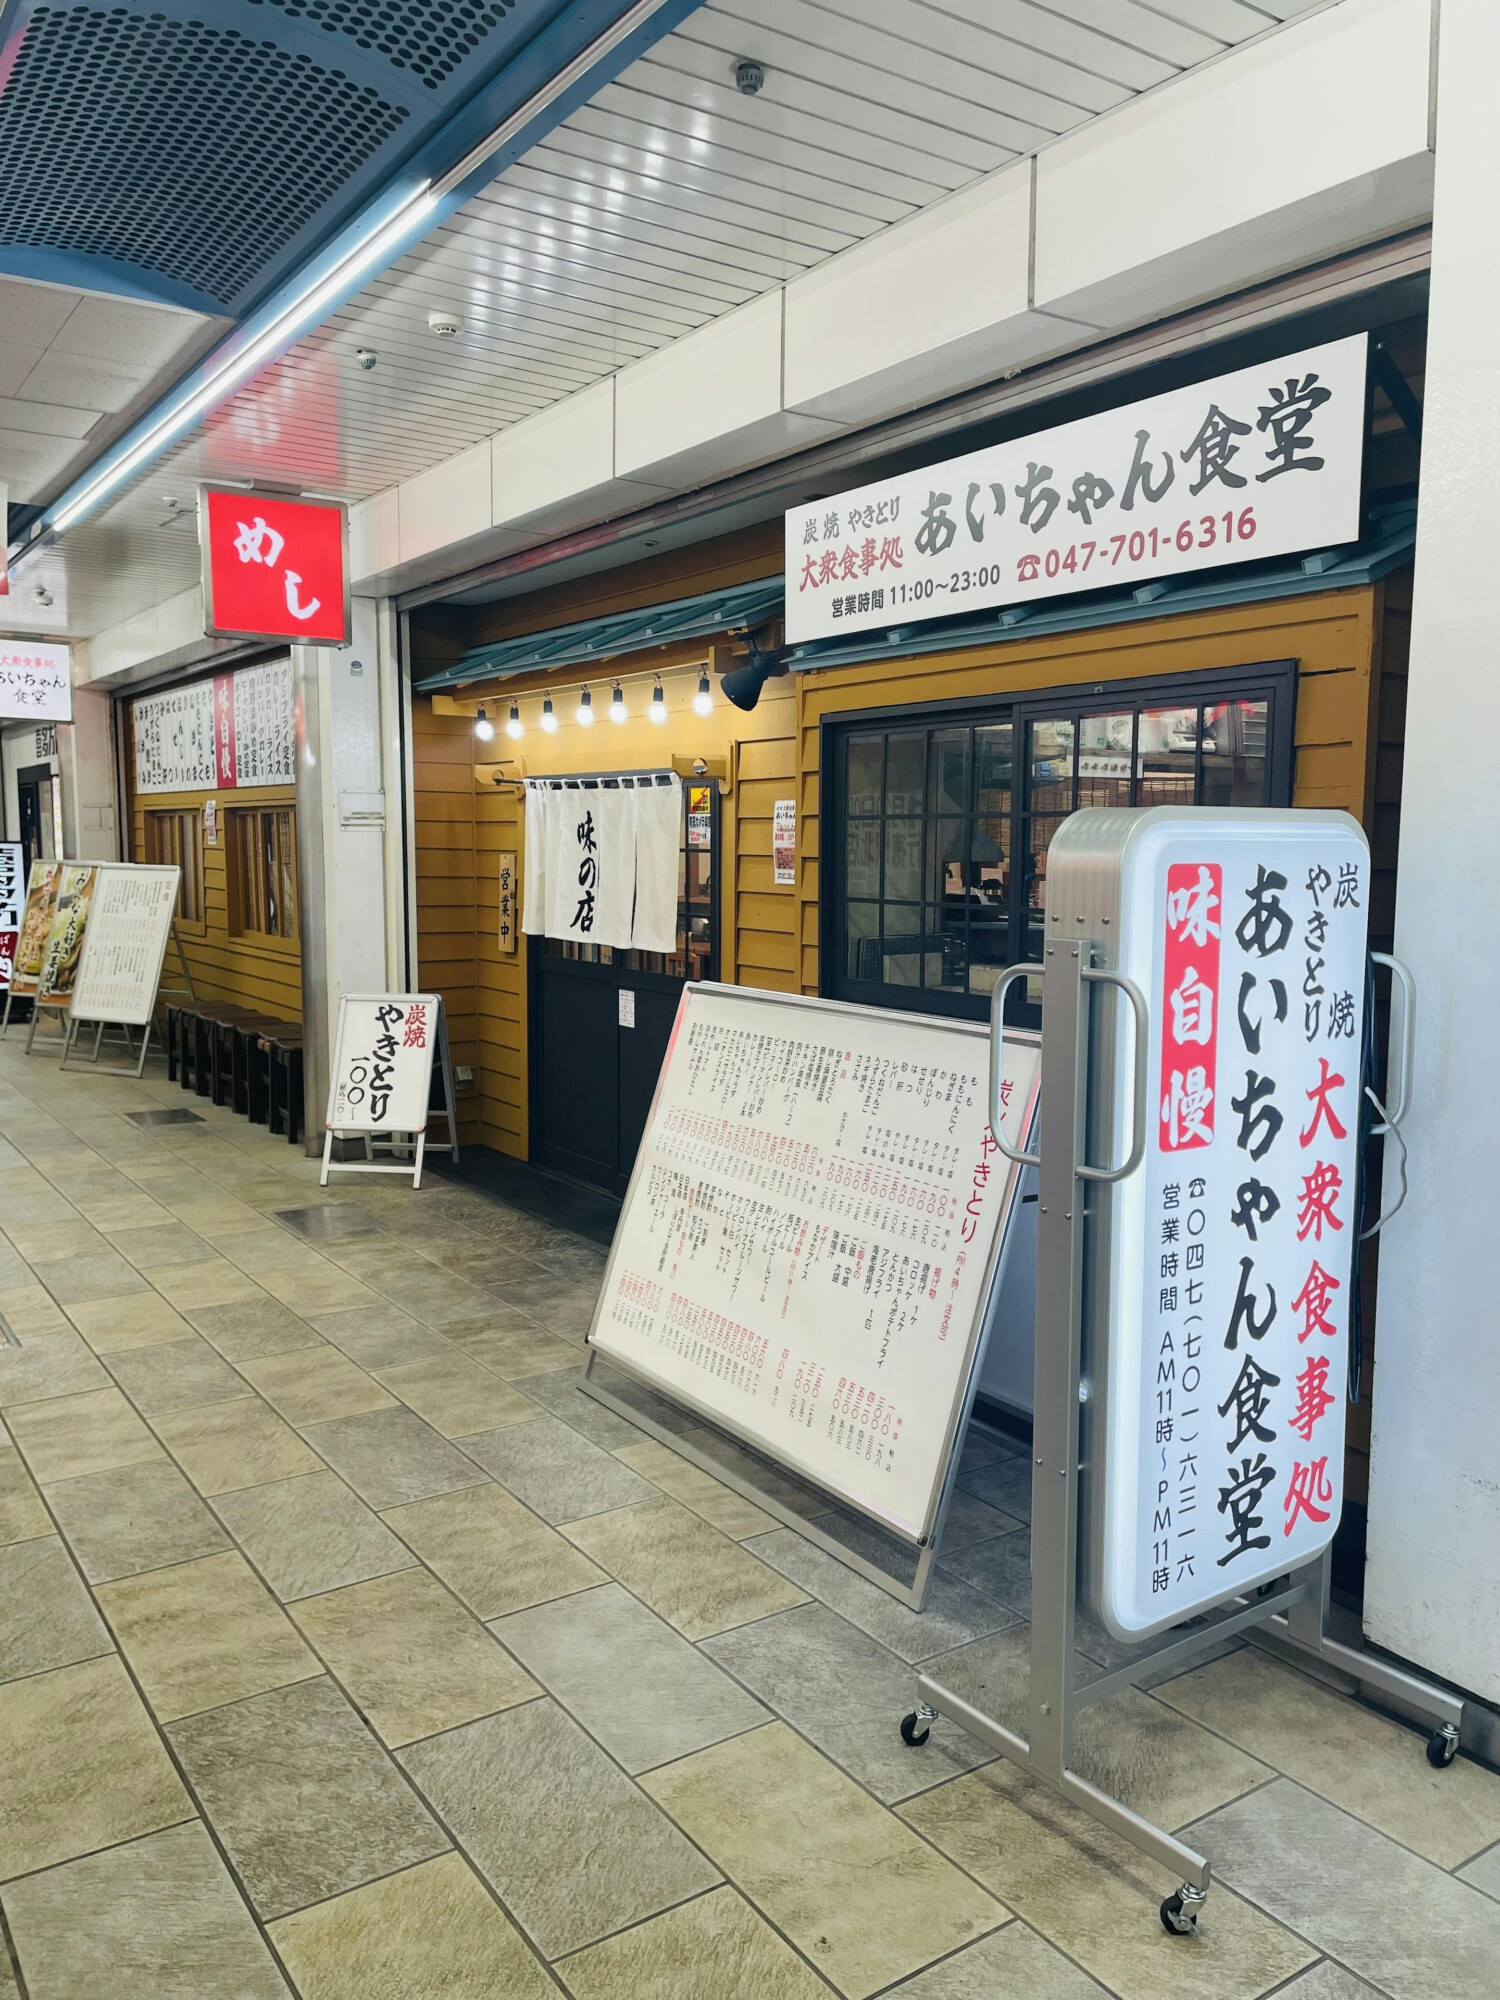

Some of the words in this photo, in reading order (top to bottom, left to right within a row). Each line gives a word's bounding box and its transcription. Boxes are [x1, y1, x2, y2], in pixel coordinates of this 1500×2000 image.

[914, 372, 1332, 557] あいちゃん食堂
[848, 497, 901, 533] やきとり
[1045, 506, 1257, 577] 047-701-6316
[233, 516, 321, 620] めし
[800, 535, 902, 591] 大衆食事処
[831, 589, 884, 618] 営業時間
[13, 690, 48, 706] 食堂
[500, 867, 511, 944] 営業中
[570, 810, 597, 933] 味の店
[1303, 864, 1332, 1043] やきとり
[403, 1004, 427, 1048] 炭焼
[1161, 865, 1221, 1148] 味自慢
[369, 1004, 404, 1123] やきとり
[1159, 1183, 1181, 1315] 営業時間
[1217, 863, 1293, 1567] あいちゃん食堂
[873, 1248, 889, 1297] アジフライ
[877, 1256, 909, 1367] あいちゃんポテトフライ
[886, 1252, 899, 1292] とんかつ
[905, 1259, 919, 1300] コロッケ
[1284, 1058, 1348, 1538] 大衆食事処
